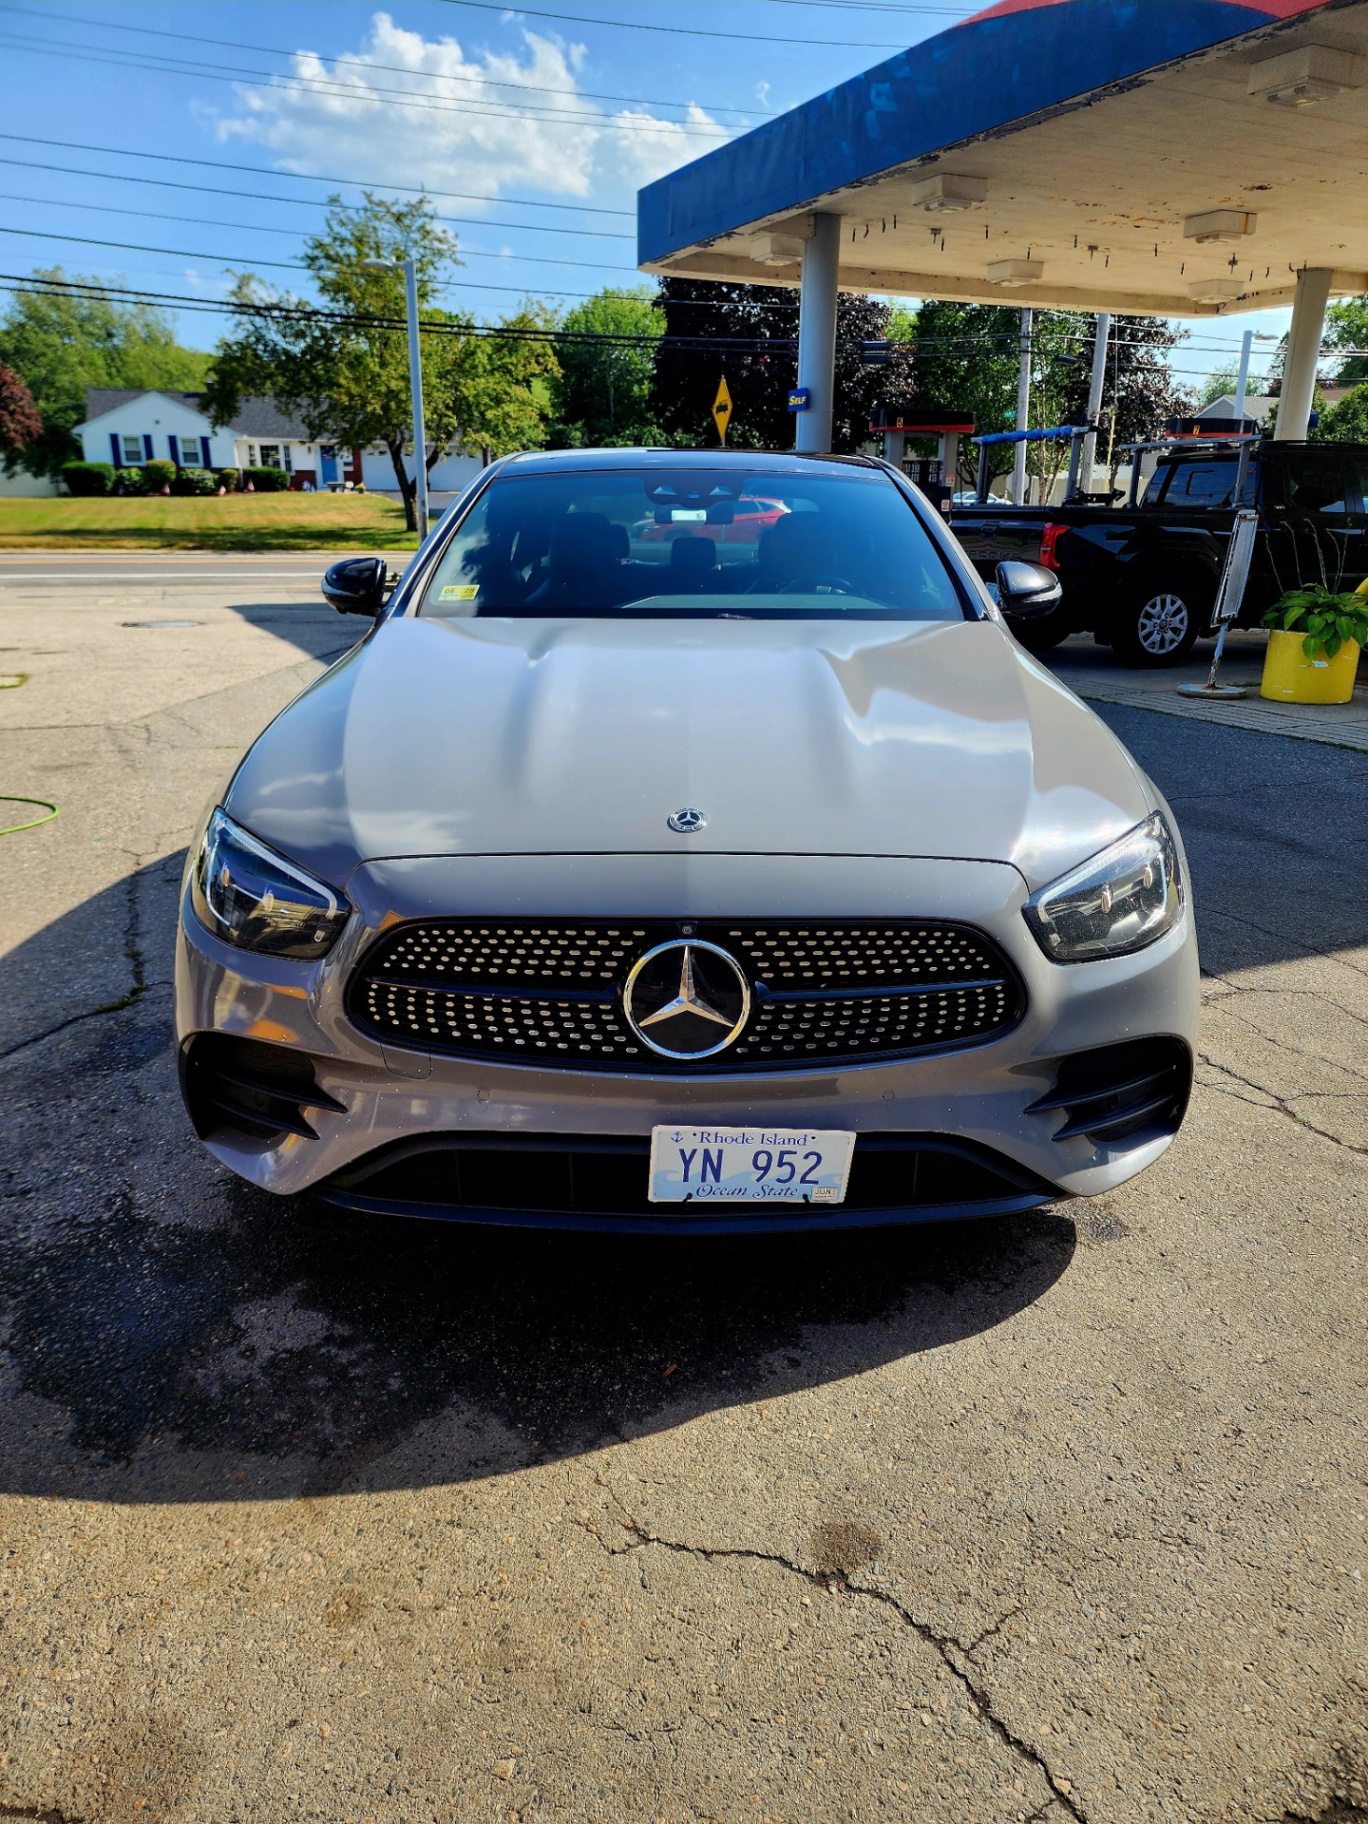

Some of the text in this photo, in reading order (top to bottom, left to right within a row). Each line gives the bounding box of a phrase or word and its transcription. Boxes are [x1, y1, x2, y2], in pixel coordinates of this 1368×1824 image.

[969, 550, 1023, 561] ACOMA
[698, 1131, 808, 1146] Rhode Island
[679, 1148, 823, 1185] YN 952
[696, 1184, 798, 1199] Ocean State
